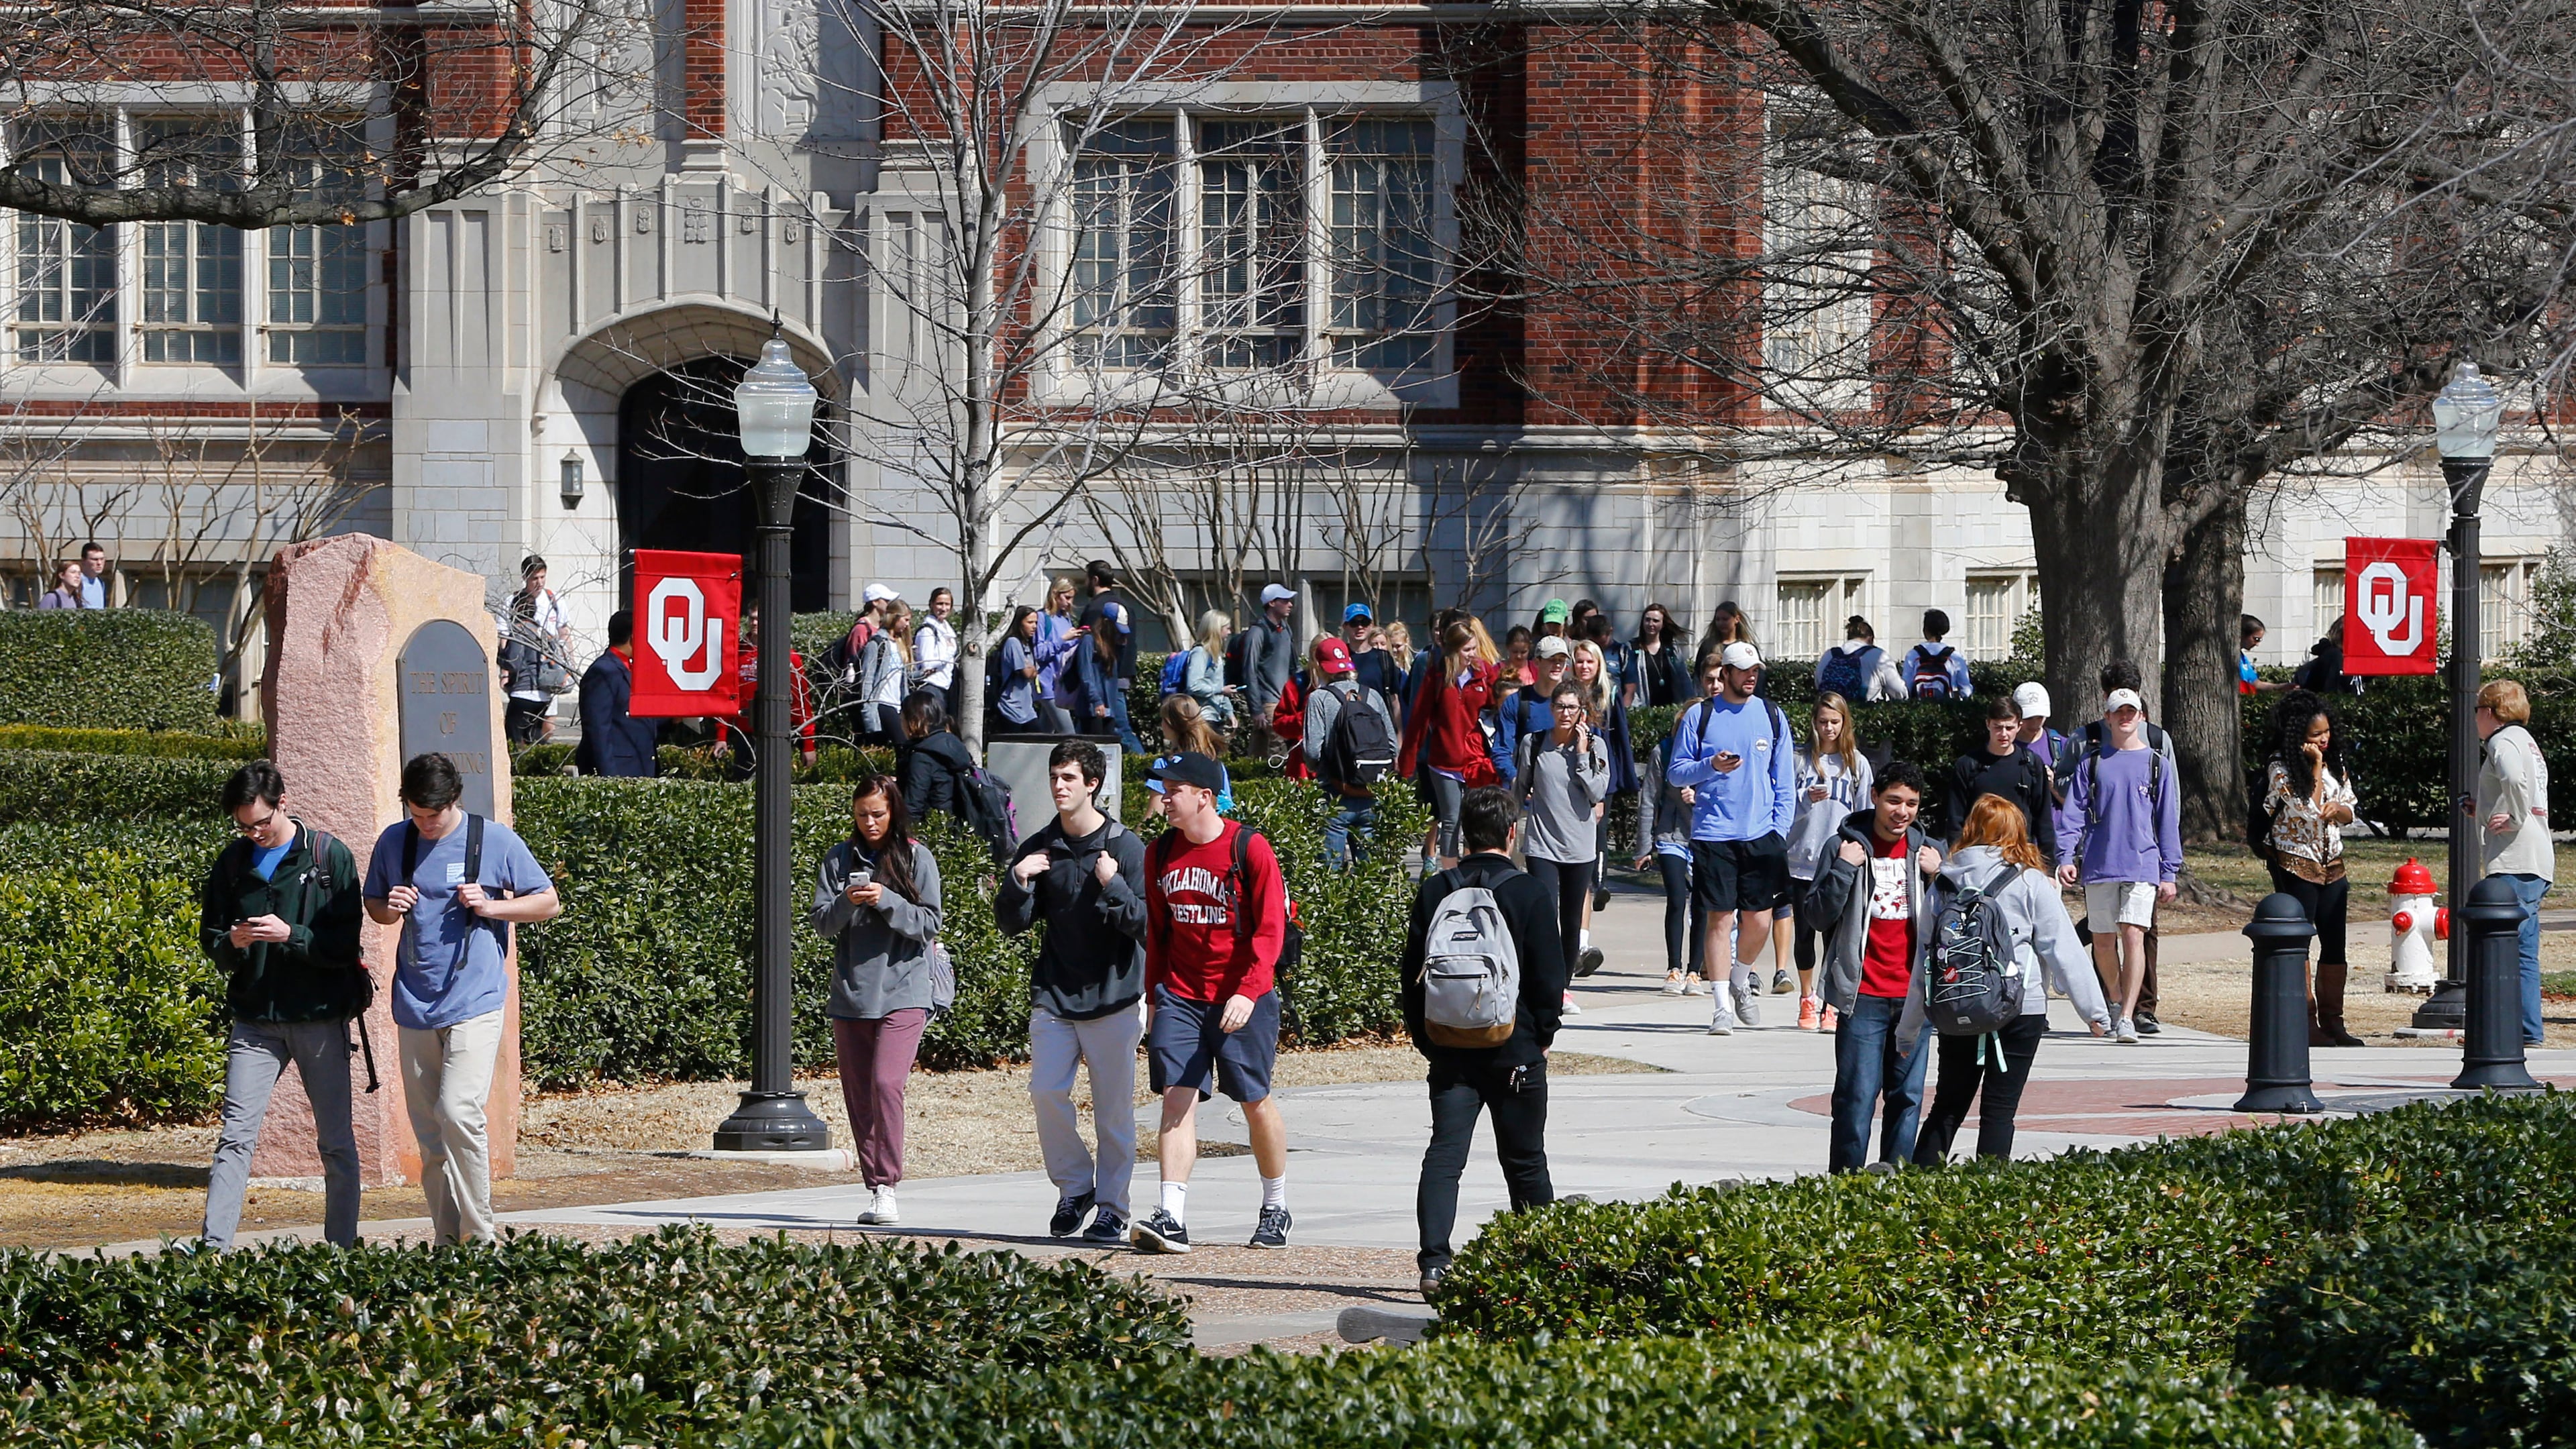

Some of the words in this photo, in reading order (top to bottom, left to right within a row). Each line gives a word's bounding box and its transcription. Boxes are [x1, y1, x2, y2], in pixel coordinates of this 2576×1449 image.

[2357, 561, 2424, 655] OU
[647, 577, 722, 690] OU
[410, 673, 435, 694] THE
[441, 673, 483, 694] SPIRIT
[440, 712, 456, 733] OF
[1161, 866, 1228, 907] OKLAHOMA
